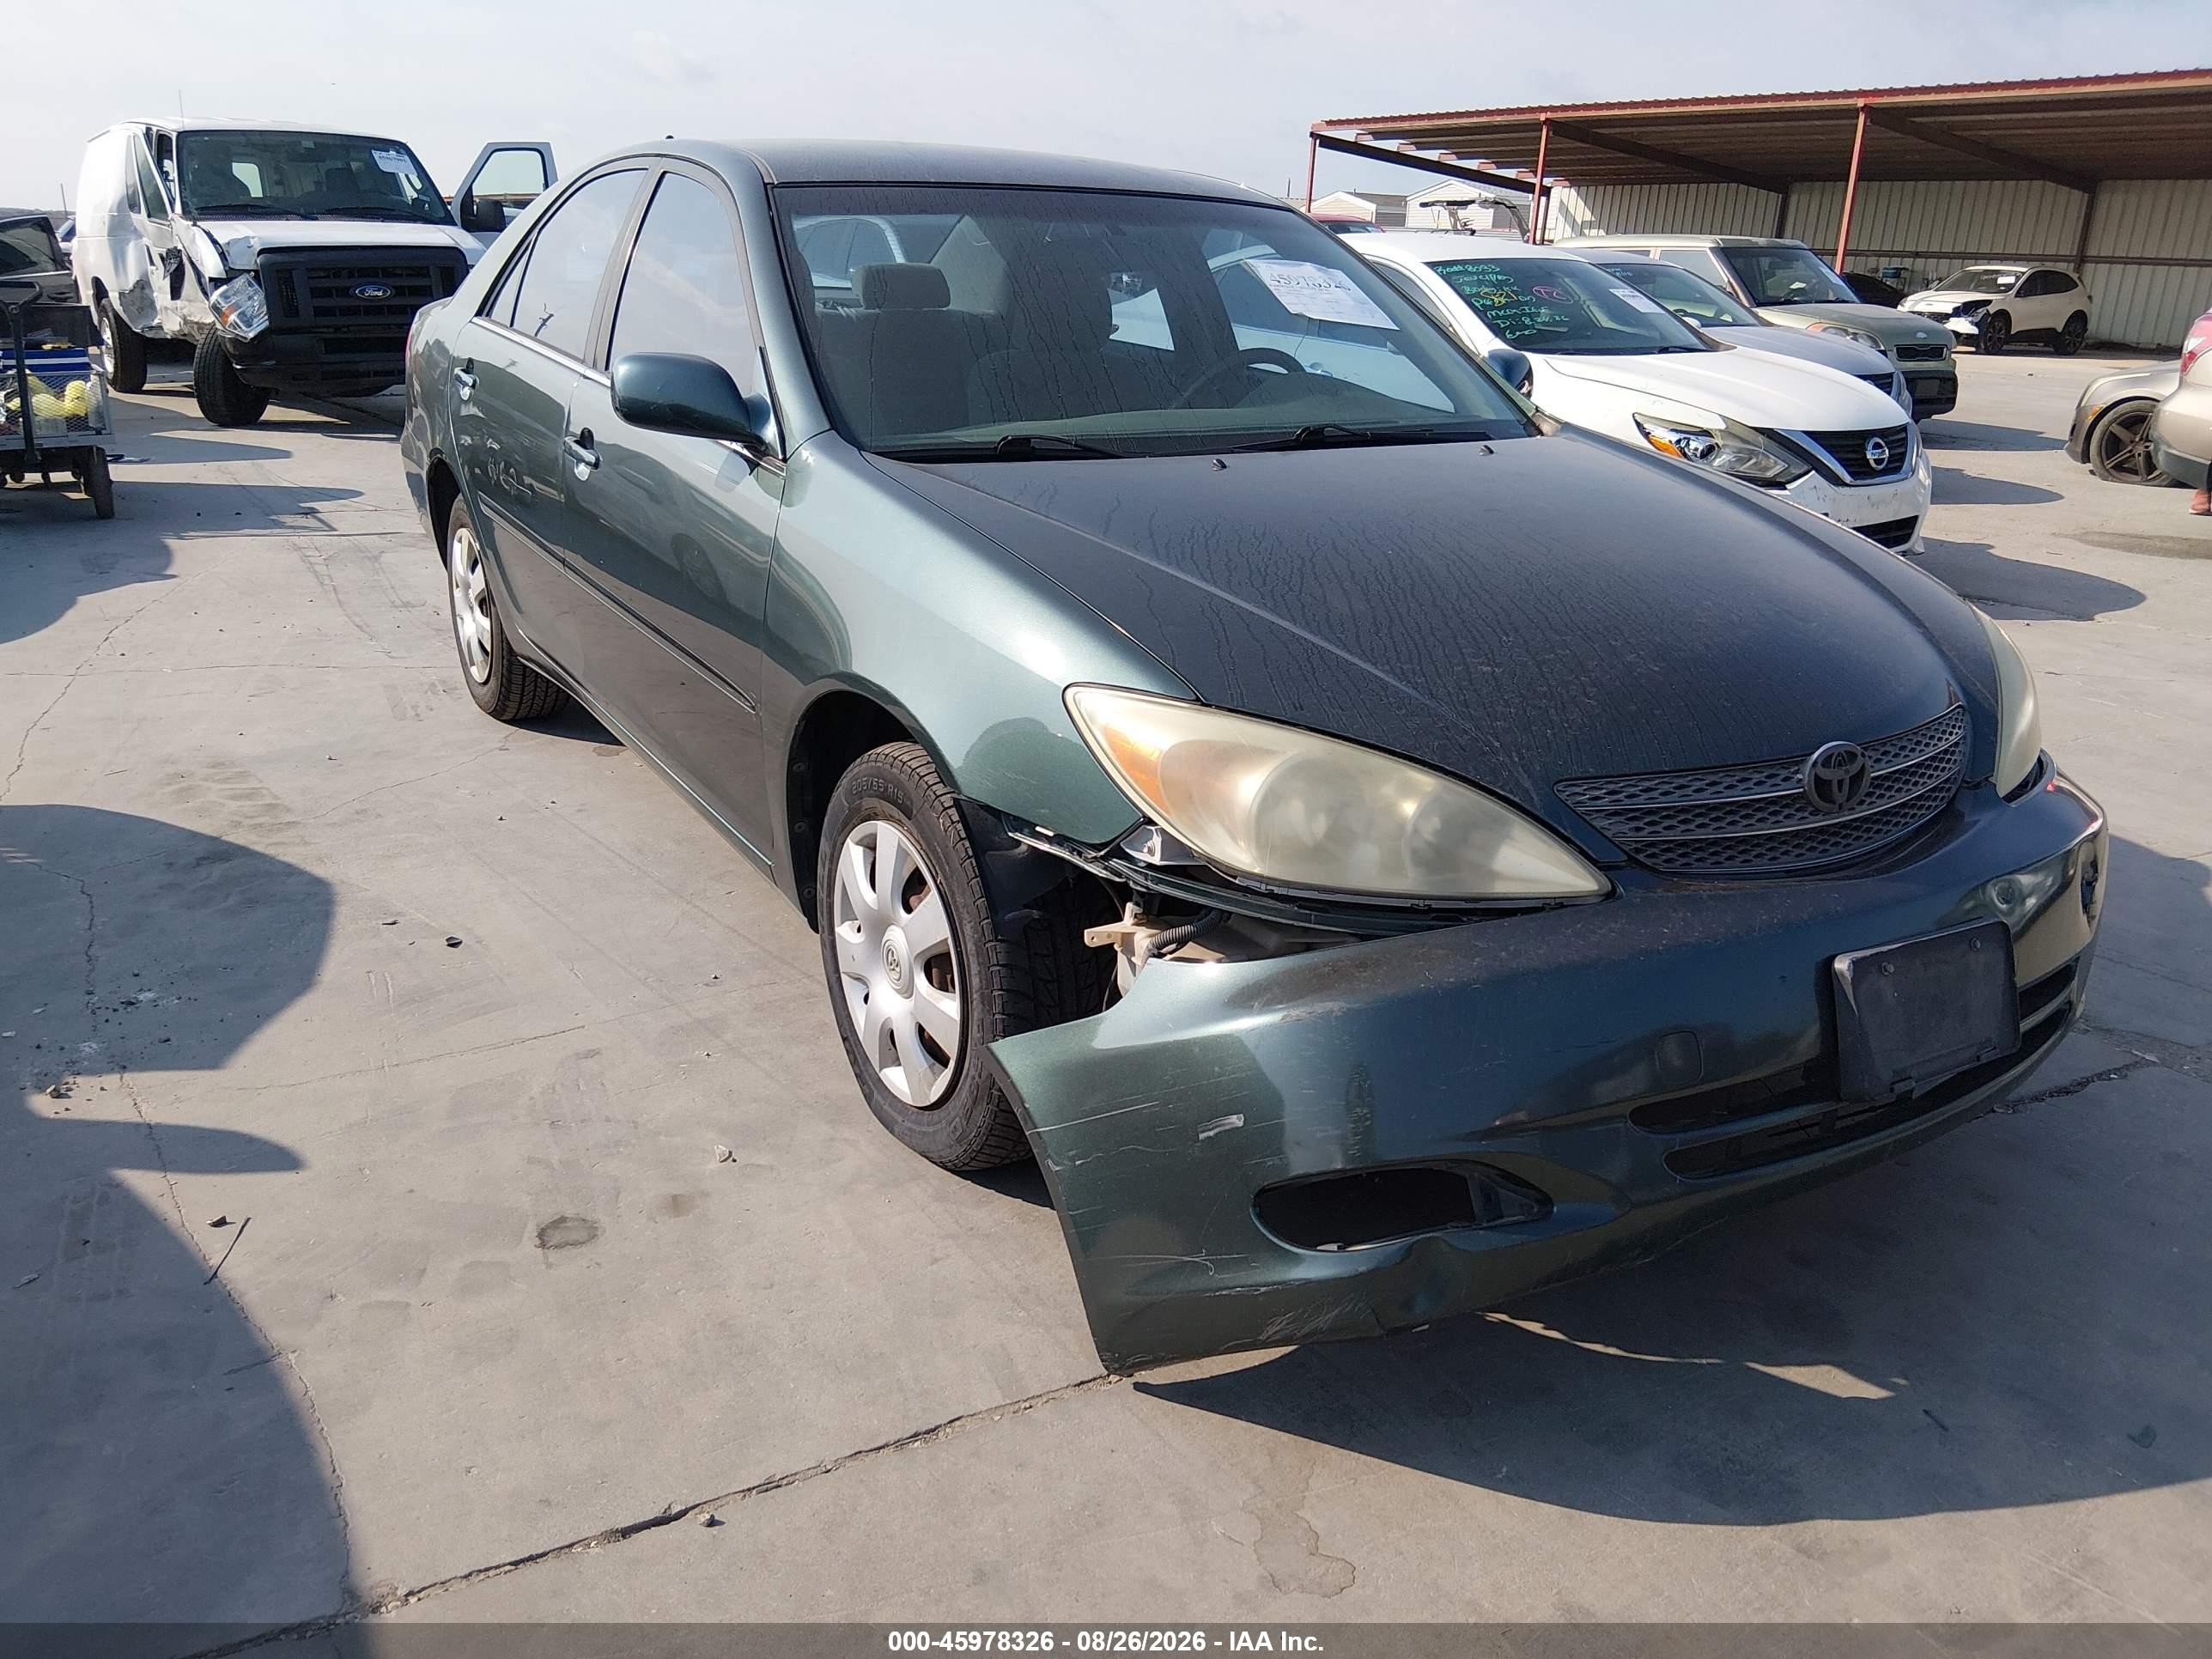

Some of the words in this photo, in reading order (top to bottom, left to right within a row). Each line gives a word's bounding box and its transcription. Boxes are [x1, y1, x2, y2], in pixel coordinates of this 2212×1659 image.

[364, 287, 384, 296] Ford
[851, 776, 885, 794] 205/65
[887, 782, 904, 805] R15
